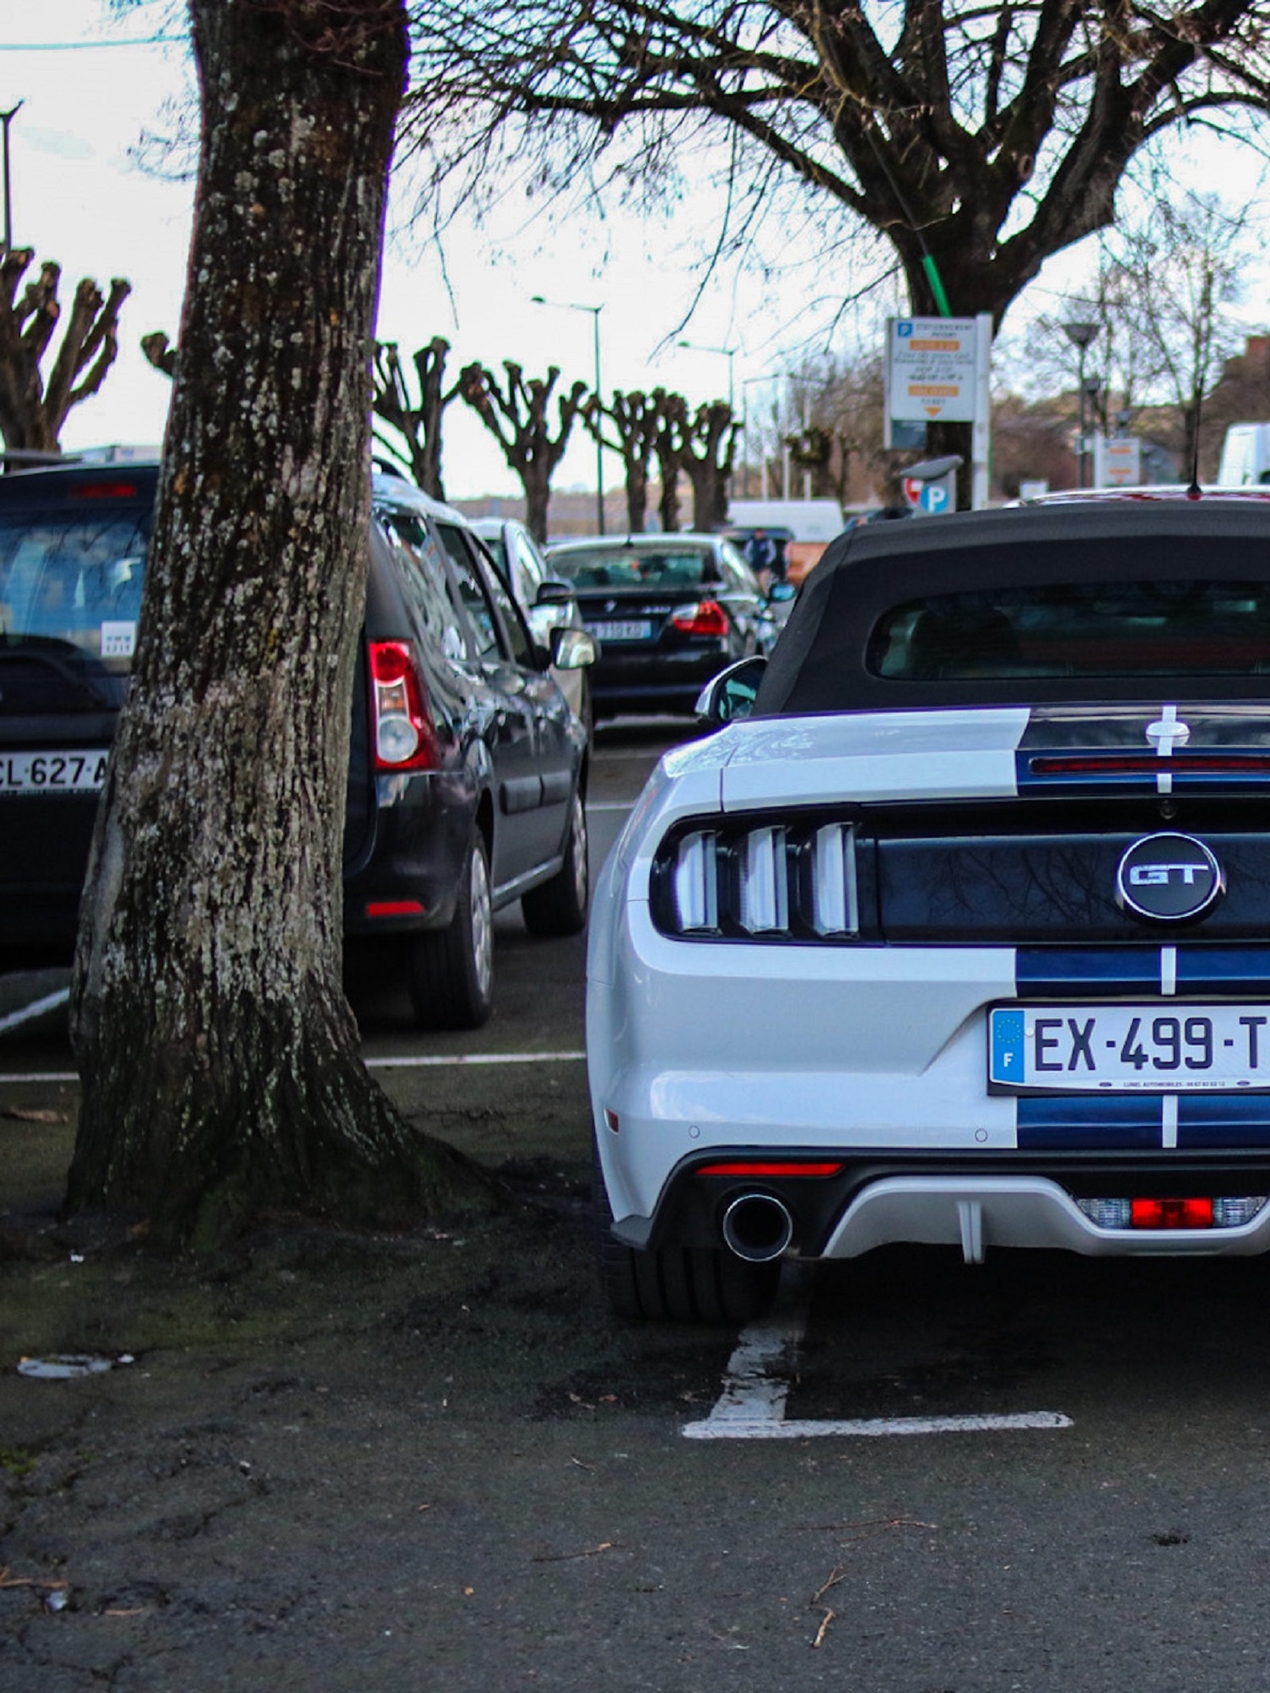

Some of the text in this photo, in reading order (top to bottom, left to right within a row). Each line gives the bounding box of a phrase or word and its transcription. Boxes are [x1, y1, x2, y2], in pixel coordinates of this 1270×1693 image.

[928, 486, 946, 512] P
[1129, 864, 1209, 885] GT
[1003, 1052, 1014, 1068] F
